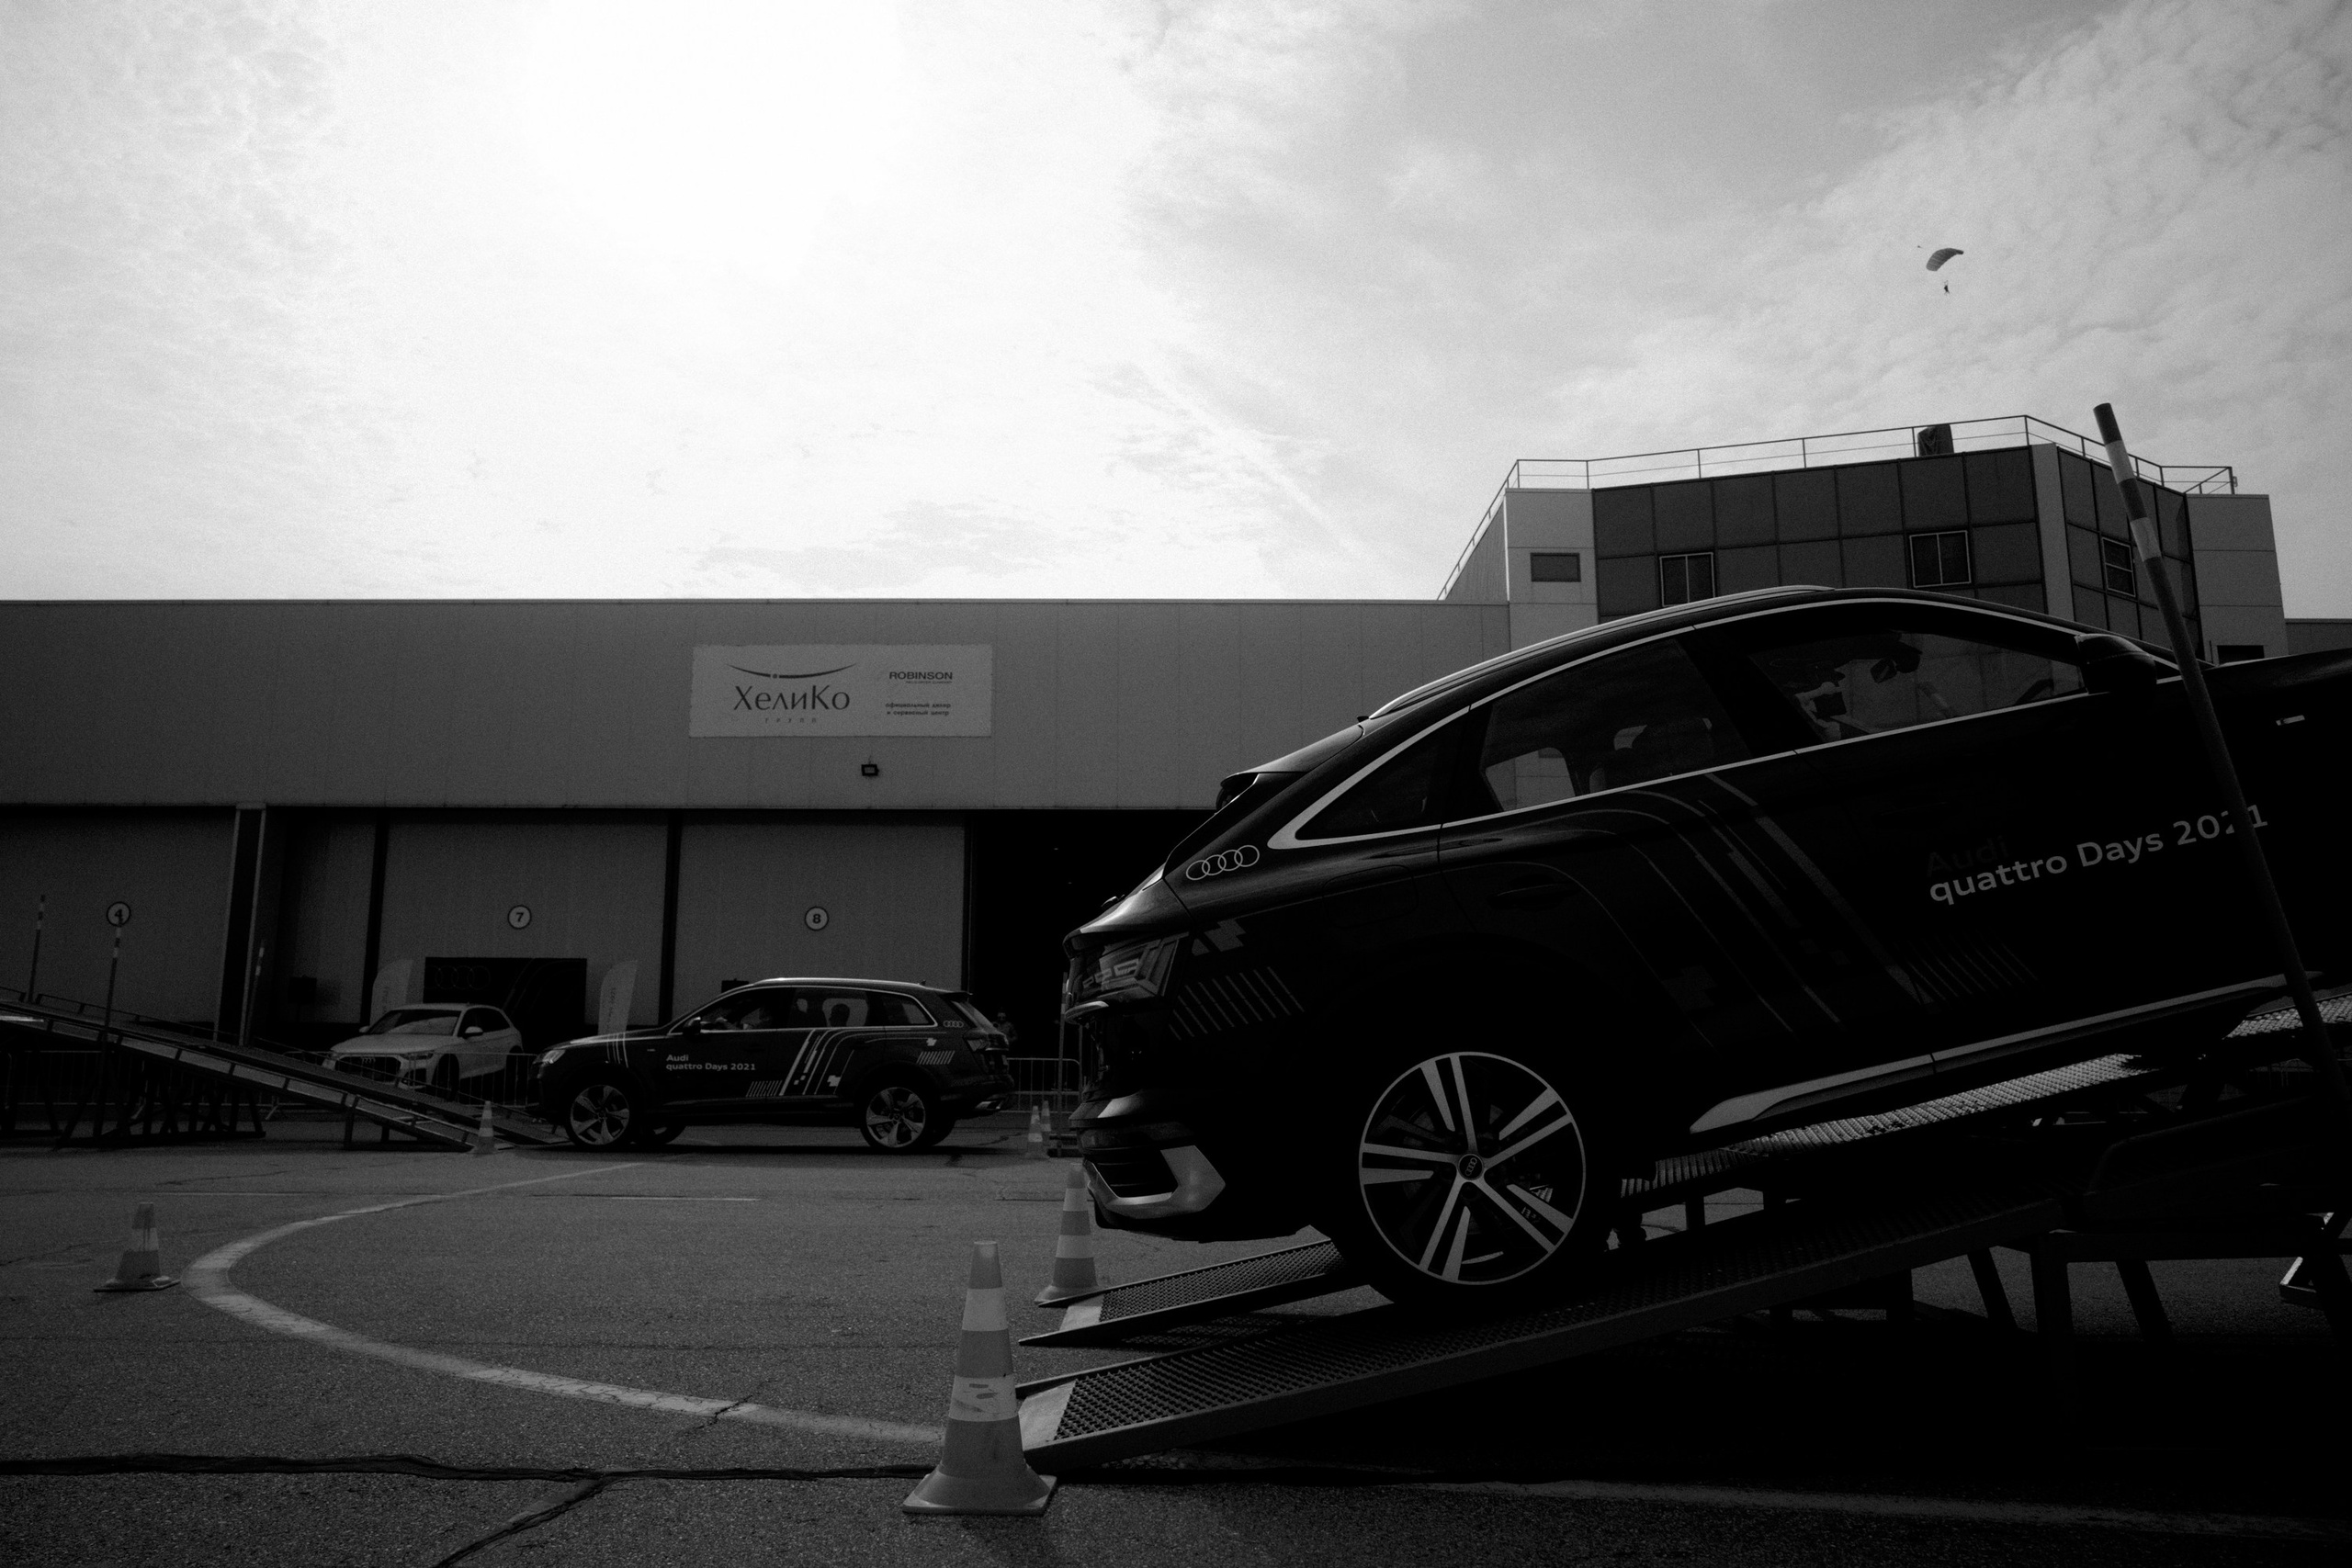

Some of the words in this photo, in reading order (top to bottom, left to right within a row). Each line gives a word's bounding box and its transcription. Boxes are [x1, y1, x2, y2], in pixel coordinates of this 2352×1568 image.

[888, 671, 953, 680] ROBINSON
[734, 685, 850, 710] ХелиКо
[1927, 834, 2010, 876] Audi
[1929, 854, 2068, 906] quattro
[2076, 831, 2165, 867] Days
[516, 912, 524, 922] 7
[813, 913, 821, 924] 8
[665, 1054, 689, 1062] Audi
[665, 1063, 703, 1071] quattro
[705, 1062, 729, 1072] Days
[730, 1063, 756, 1071] 2021
